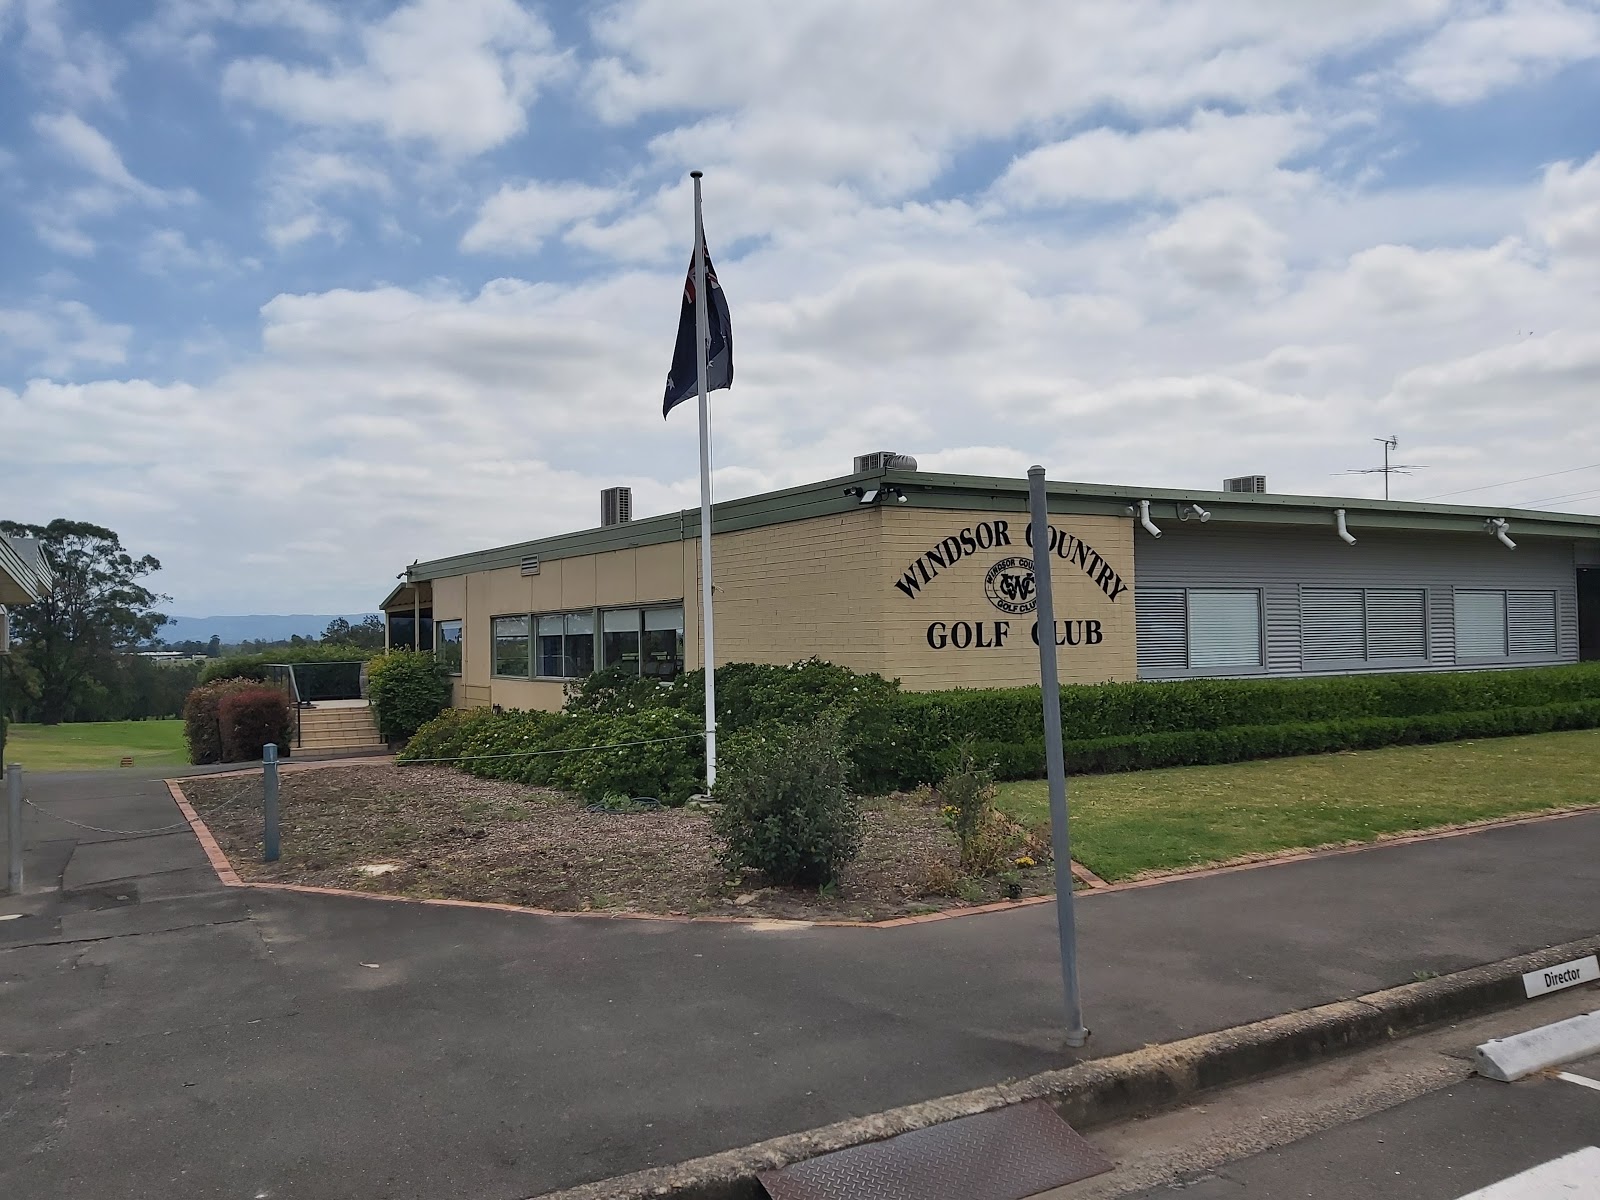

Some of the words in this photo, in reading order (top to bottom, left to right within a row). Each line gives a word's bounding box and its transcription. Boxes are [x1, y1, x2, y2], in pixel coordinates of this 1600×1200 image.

[894, 520, 1011, 599] WINDSOR
[987, 559, 1015, 584] WINDSOR
[997, 600, 1018, 612] GOLF
[1020, 600, 1037, 612] CLU
[926, 621, 1009, 649] GOLF
[1544, 968, 1580, 987] Director
